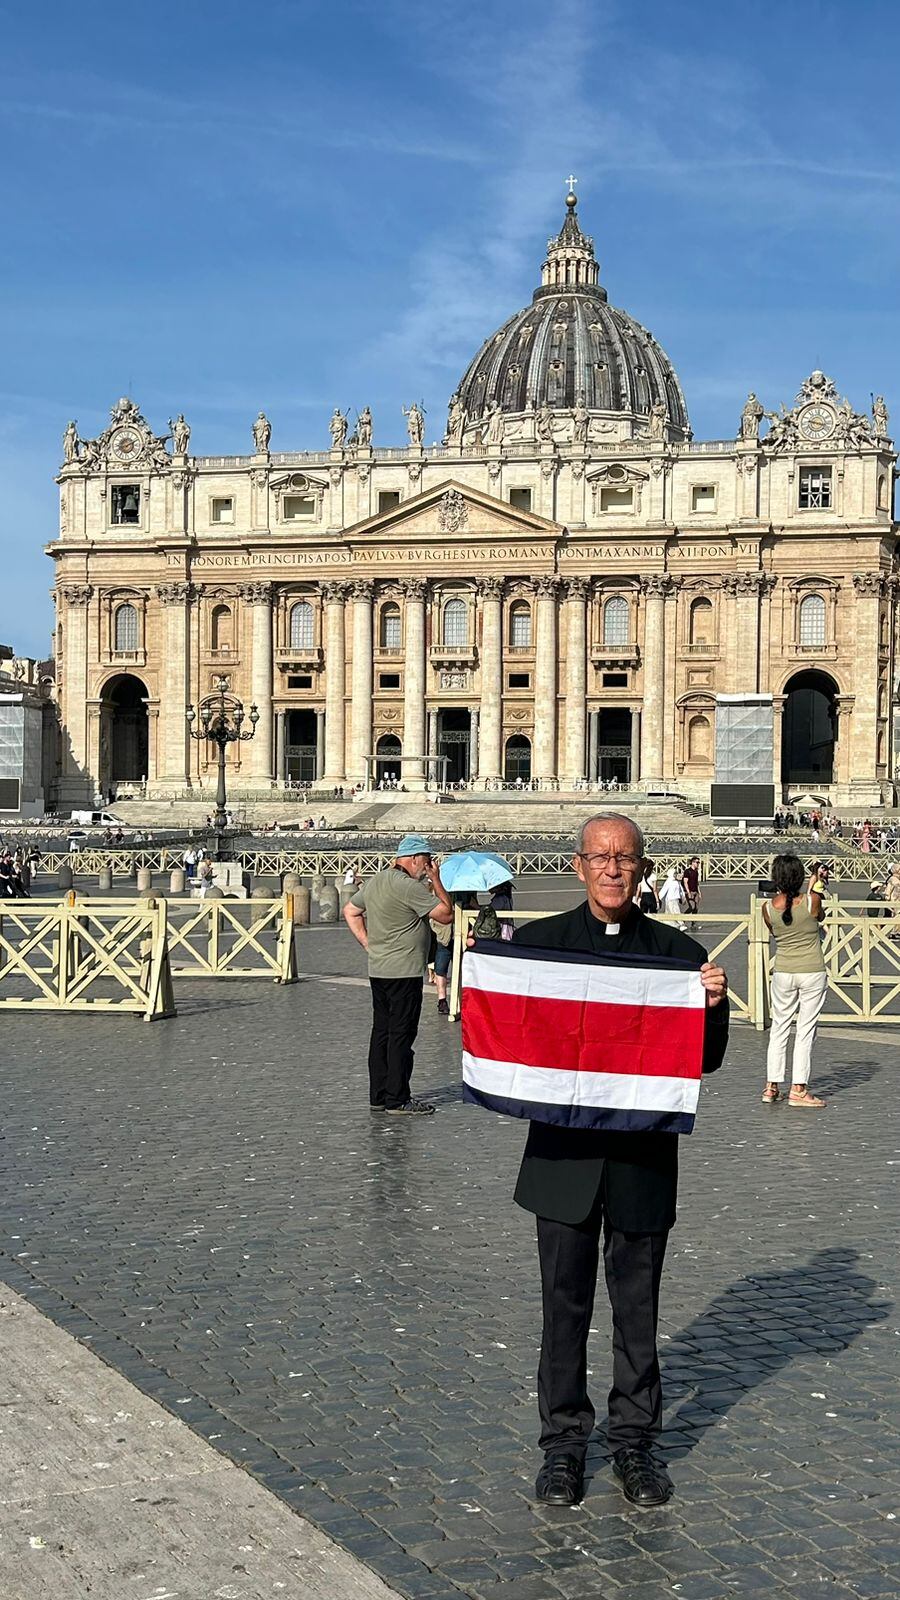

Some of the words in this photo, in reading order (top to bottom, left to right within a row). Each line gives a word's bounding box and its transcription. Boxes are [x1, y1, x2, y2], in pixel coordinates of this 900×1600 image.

[167, 555, 181, 565] IN
[191, 556, 251, 566] HONOREM
[252, 554, 314, 564] PRINCIPIS
[315, 553, 352, 563] APOST
[353, 551, 396, 561] PAVLVS
[408, 550, 486, 561] BVRGHESIVS
[489, 548, 555, 559] ROMANVS
[558, 548, 593, 559] PONT
[593, 548, 621, 558] MAX
[623, 547, 641, 557] AN
[700, 546, 734, 557] PONT
[738, 544, 758, 554] VII
